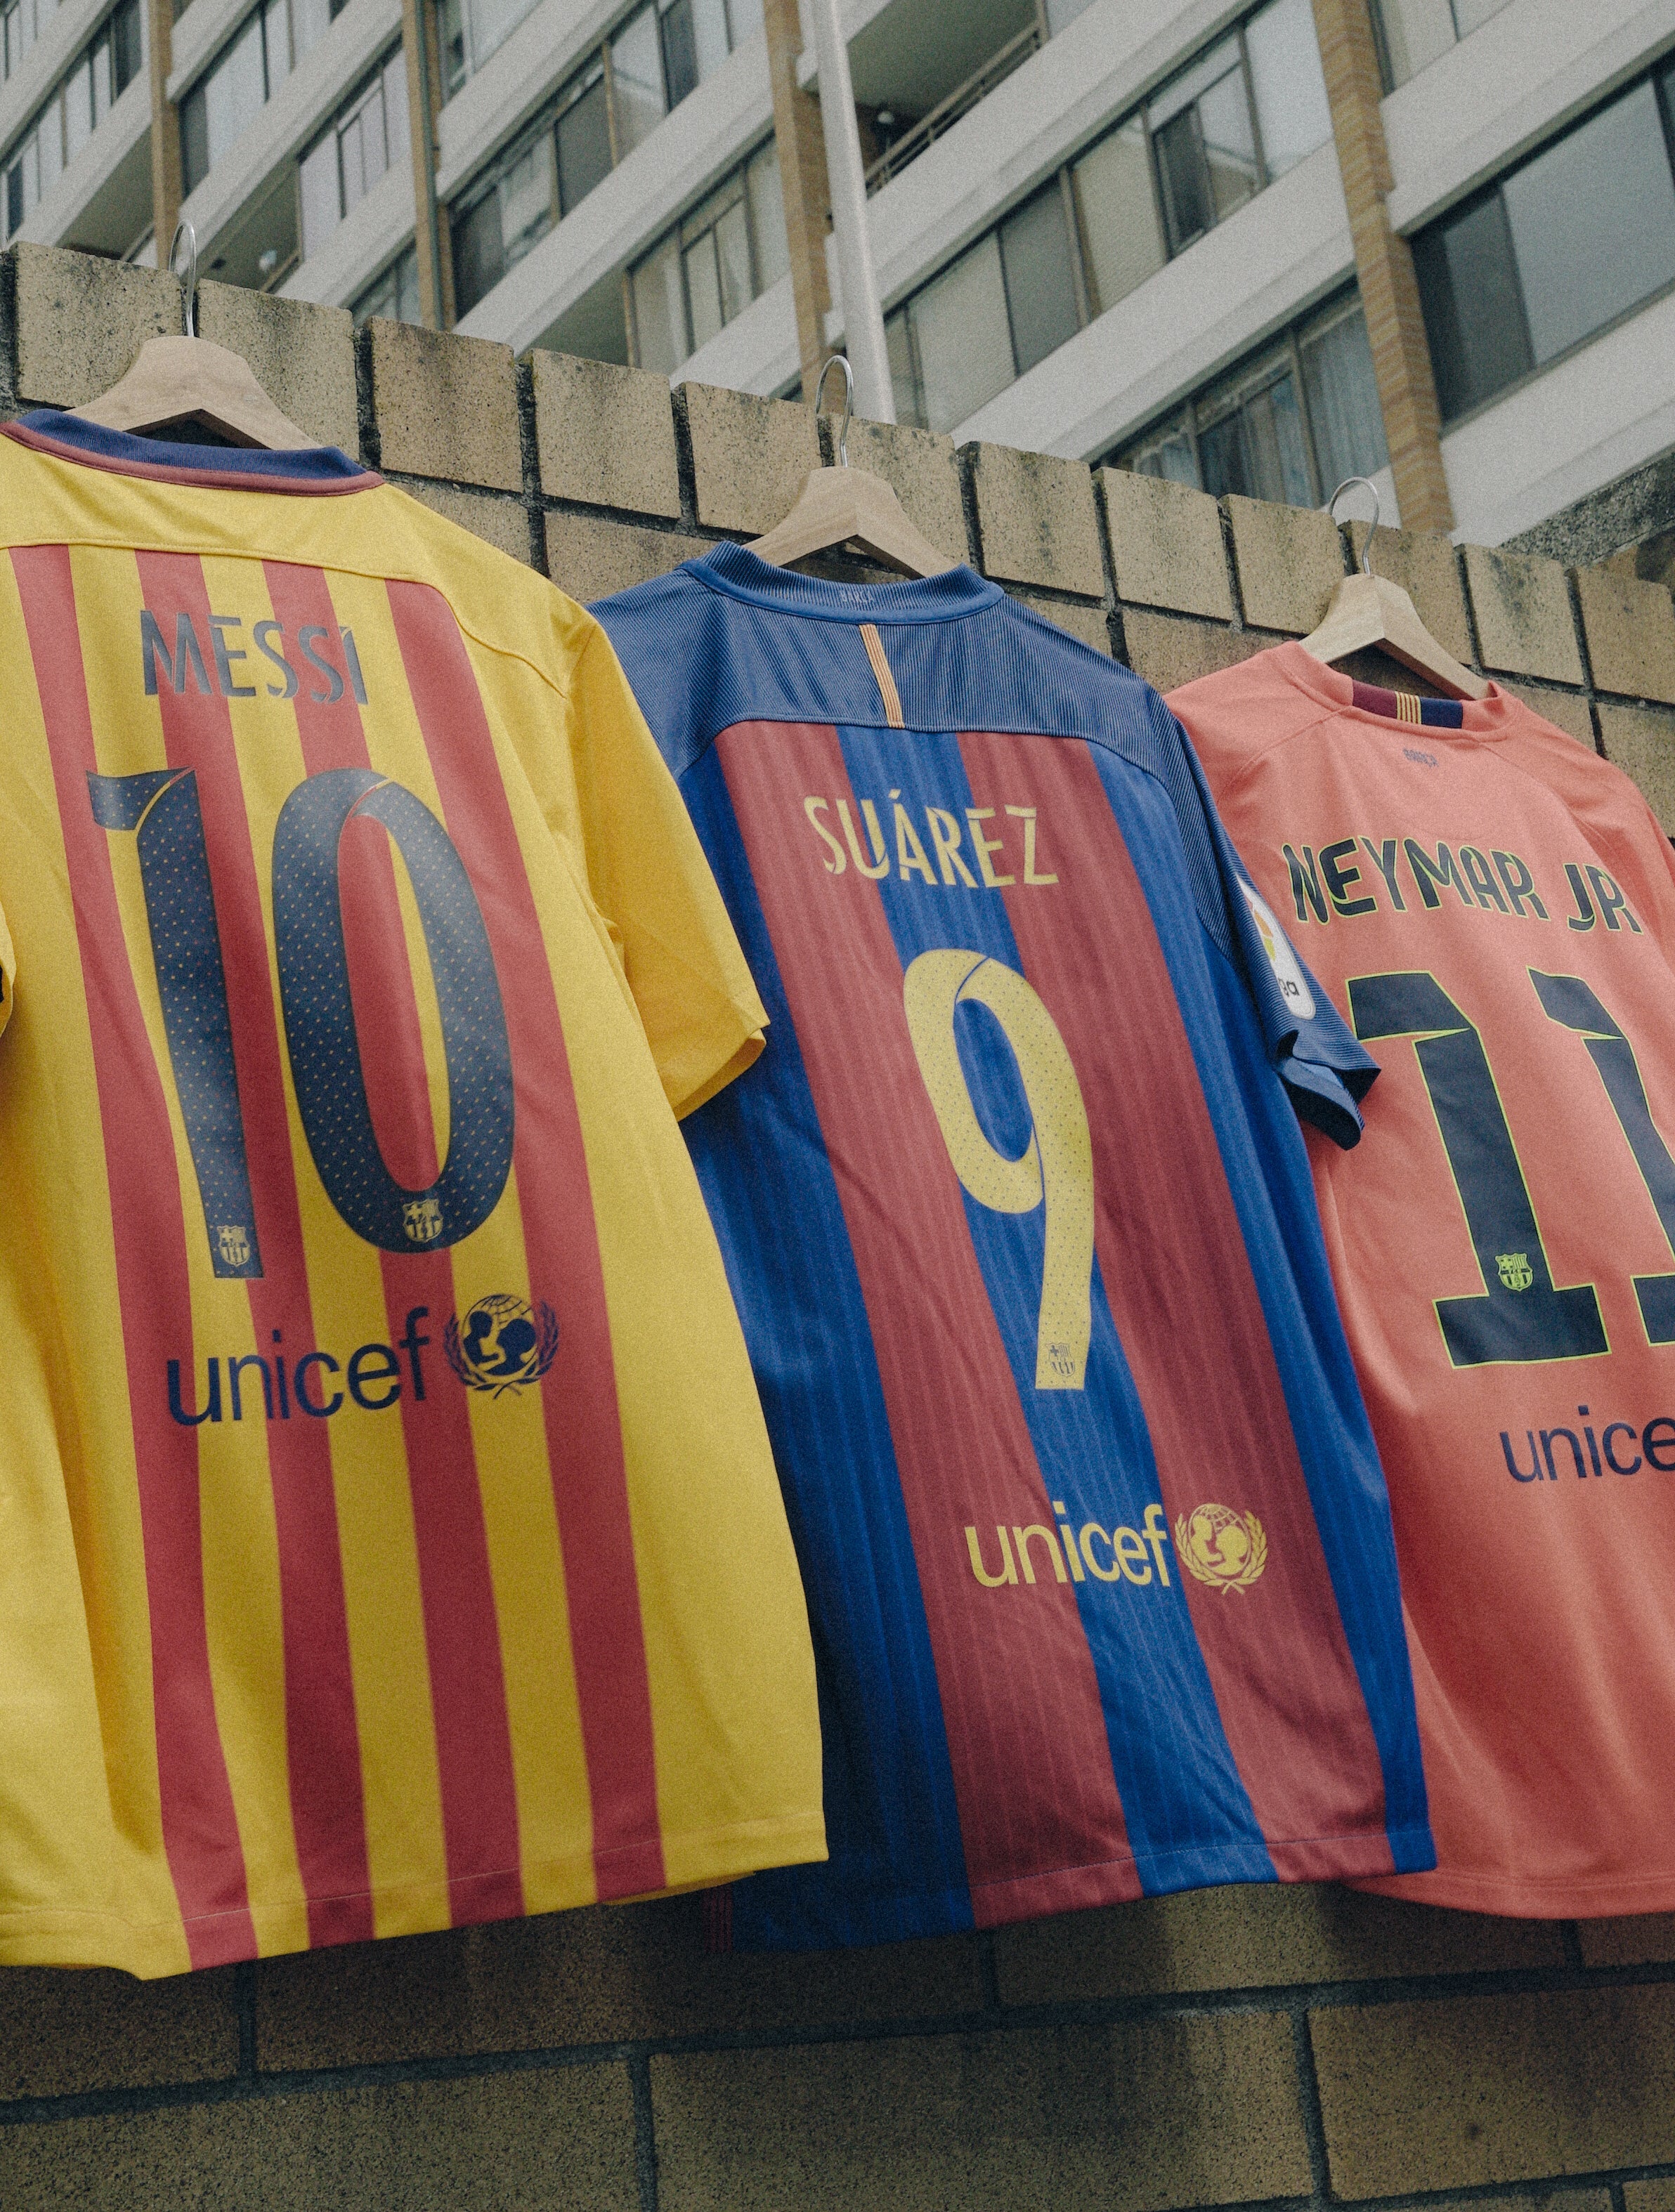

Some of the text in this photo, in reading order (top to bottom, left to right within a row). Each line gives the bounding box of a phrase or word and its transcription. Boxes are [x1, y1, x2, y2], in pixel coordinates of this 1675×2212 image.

[141, 610, 368, 705] MESSI
[803, 788, 1060, 888] SUÁREZ
[1282, 835, 1644, 935] NEYMAR JR
[86, 767, 515, 1278] 10
[904, 948, 1095, 1389] 9
[1345, 965, 1675, 1369] 11
[167, 1307, 430, 1427] unicef
[964, 1500, 1170, 1588] unicef
